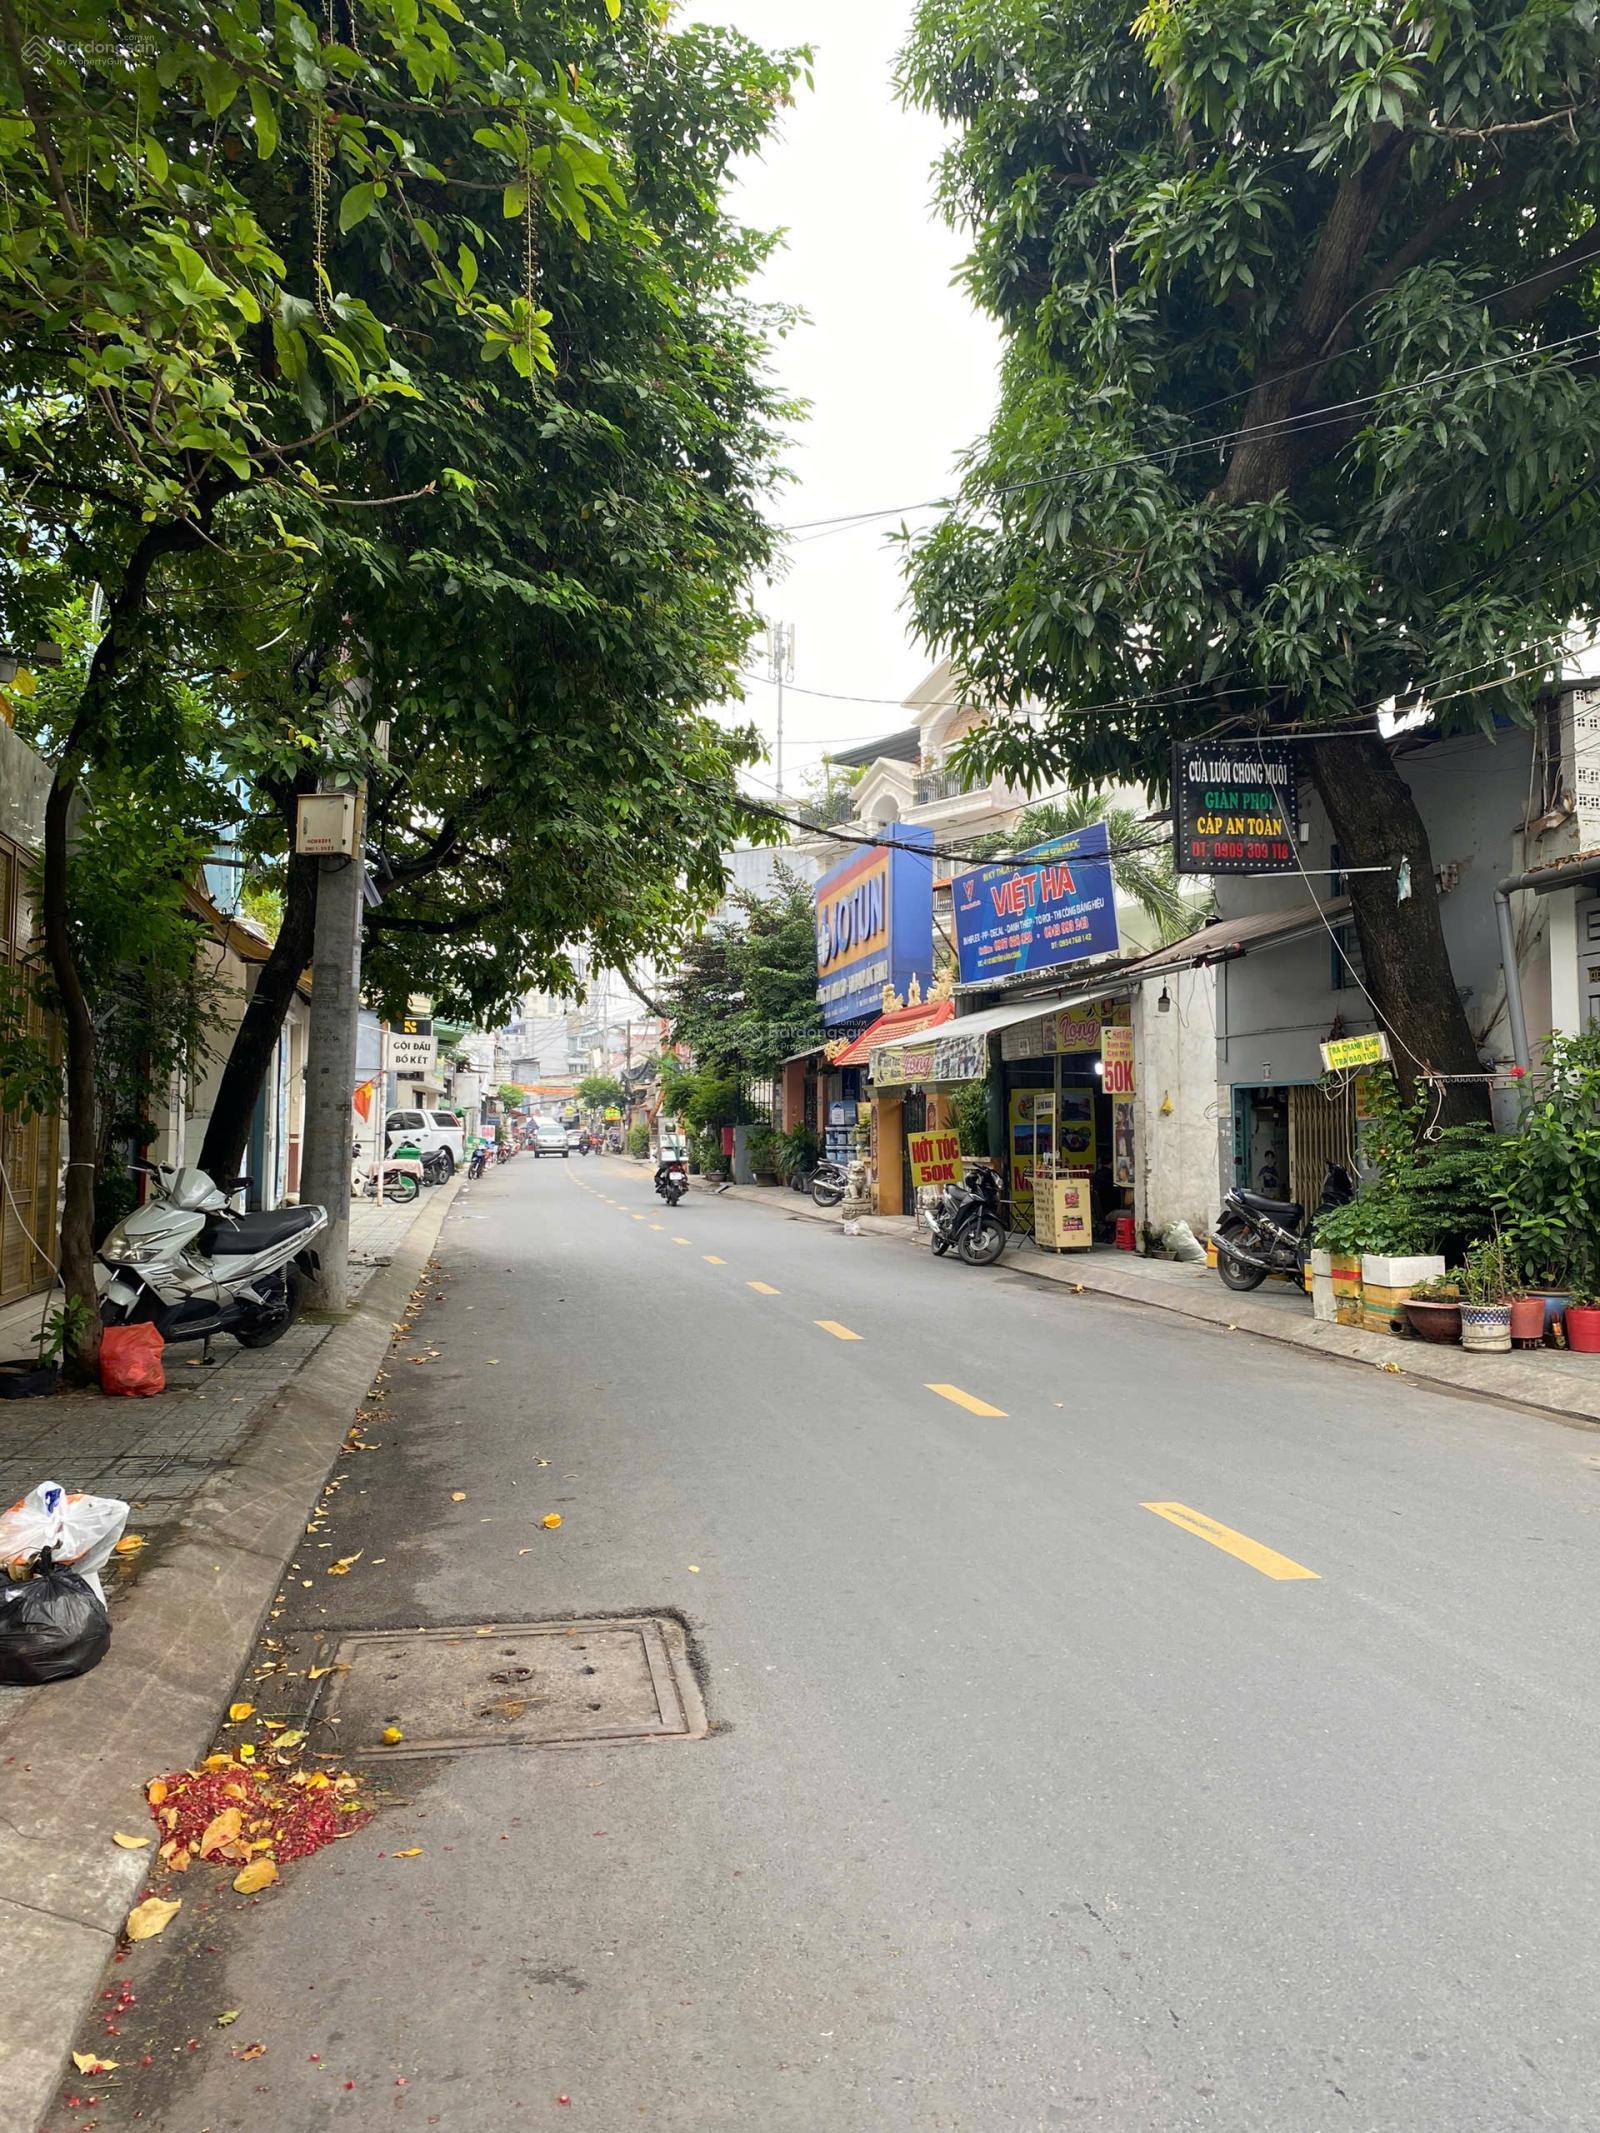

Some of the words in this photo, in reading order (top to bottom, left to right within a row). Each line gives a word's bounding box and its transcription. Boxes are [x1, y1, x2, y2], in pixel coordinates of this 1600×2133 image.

[1188, 753, 1208, 782] CỬA
[1209, 755, 1231, 783] LƯỚI
[1232, 755, 1264, 784] CHỐNG
[1204, 786, 1238, 809] GIÀN
[1242, 790, 1274, 810] PHƠI
[1196, 812, 1223, 834] CÁP
[1226, 817, 1244, 835] AN
[1247, 813, 1282, 836] TOÀN
[1214, 842, 1243, 858] 0909
[990, 872, 1038, 917] VIỆT
[831, 871, 886, 960] JOTUN
[1060, 1012, 1100, 1048] Long
[1104, 1060, 1134, 1092] 50K
[911, 1135, 934, 1164] HỚT
[937, 1133, 959, 1162] TÓC
[920, 1162, 956, 1183] 50K
